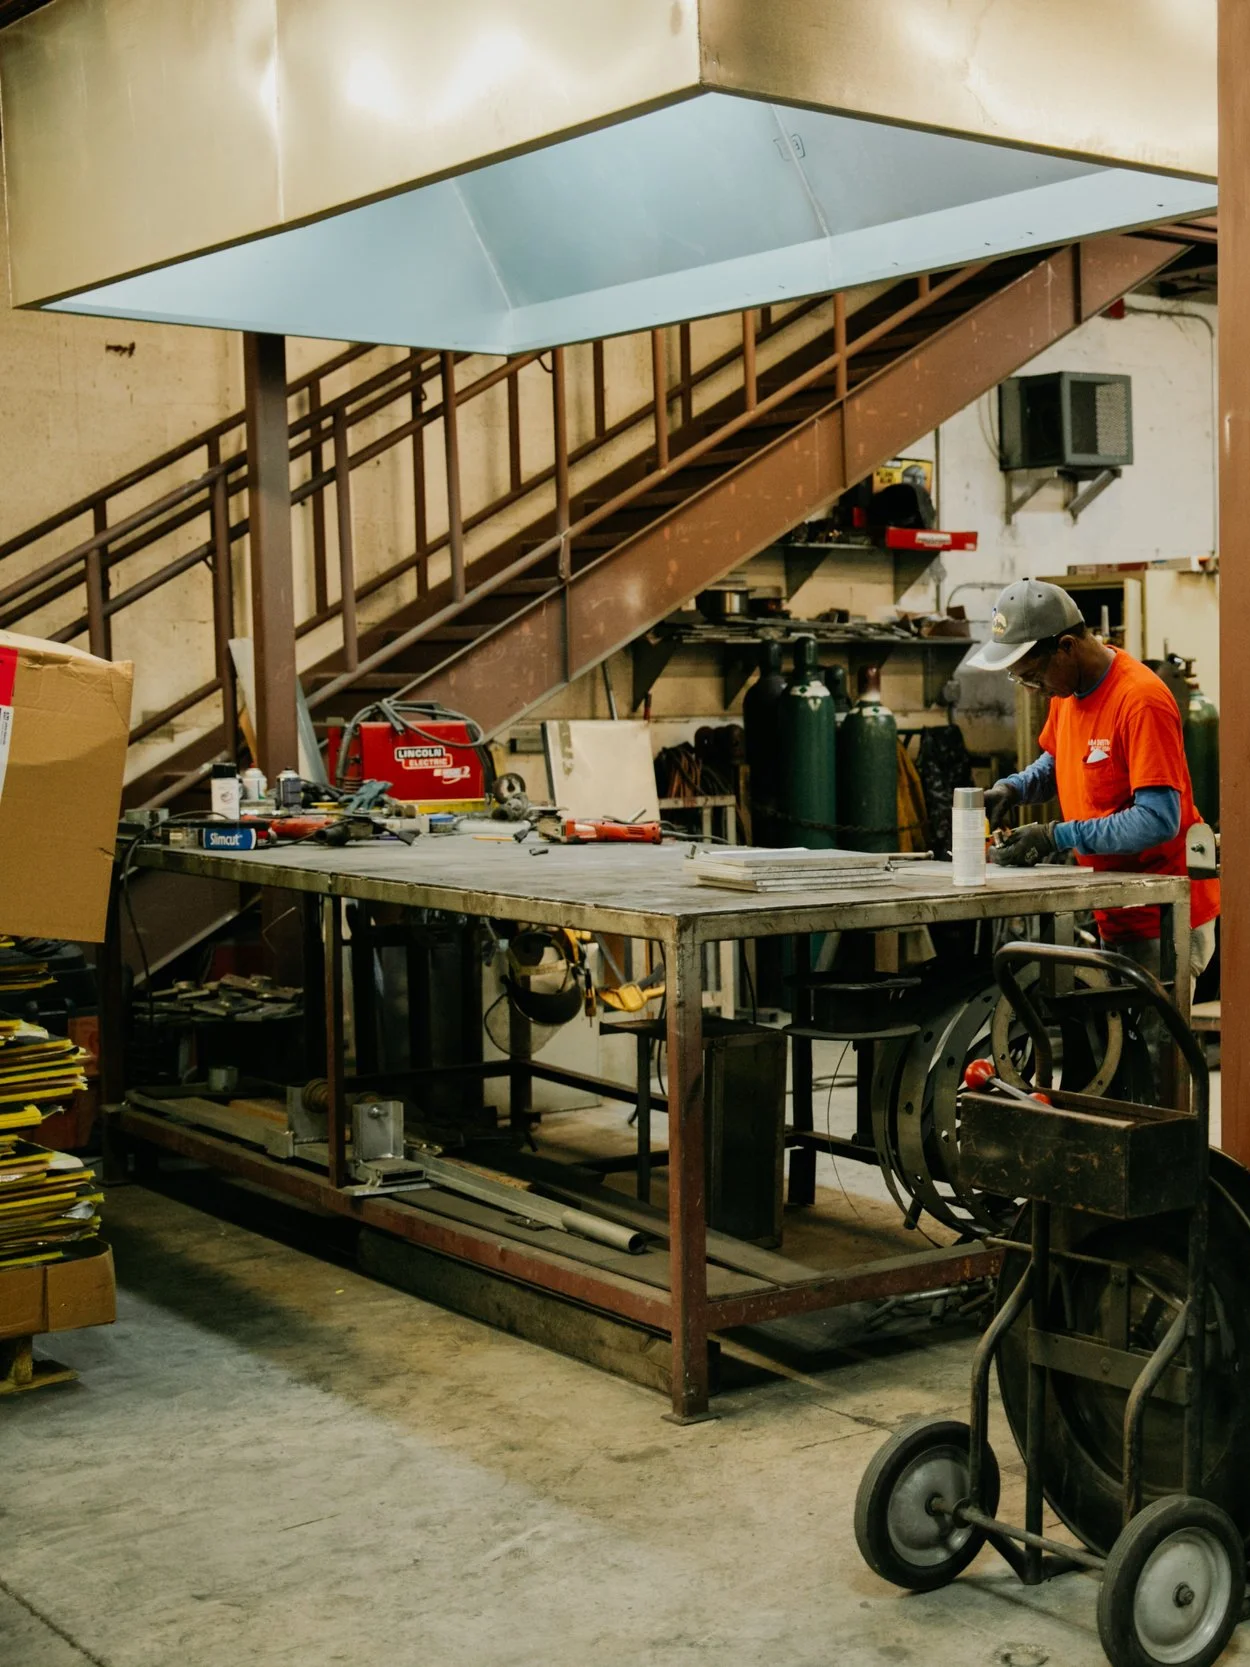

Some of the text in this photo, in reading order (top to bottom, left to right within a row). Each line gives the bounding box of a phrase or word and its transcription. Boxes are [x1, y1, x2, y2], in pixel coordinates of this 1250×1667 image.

[398, 749, 442, 758] LINCOLN
[409, 758, 447, 767] ELECTRIC
[210, 832, 240, 845] Slimcut
